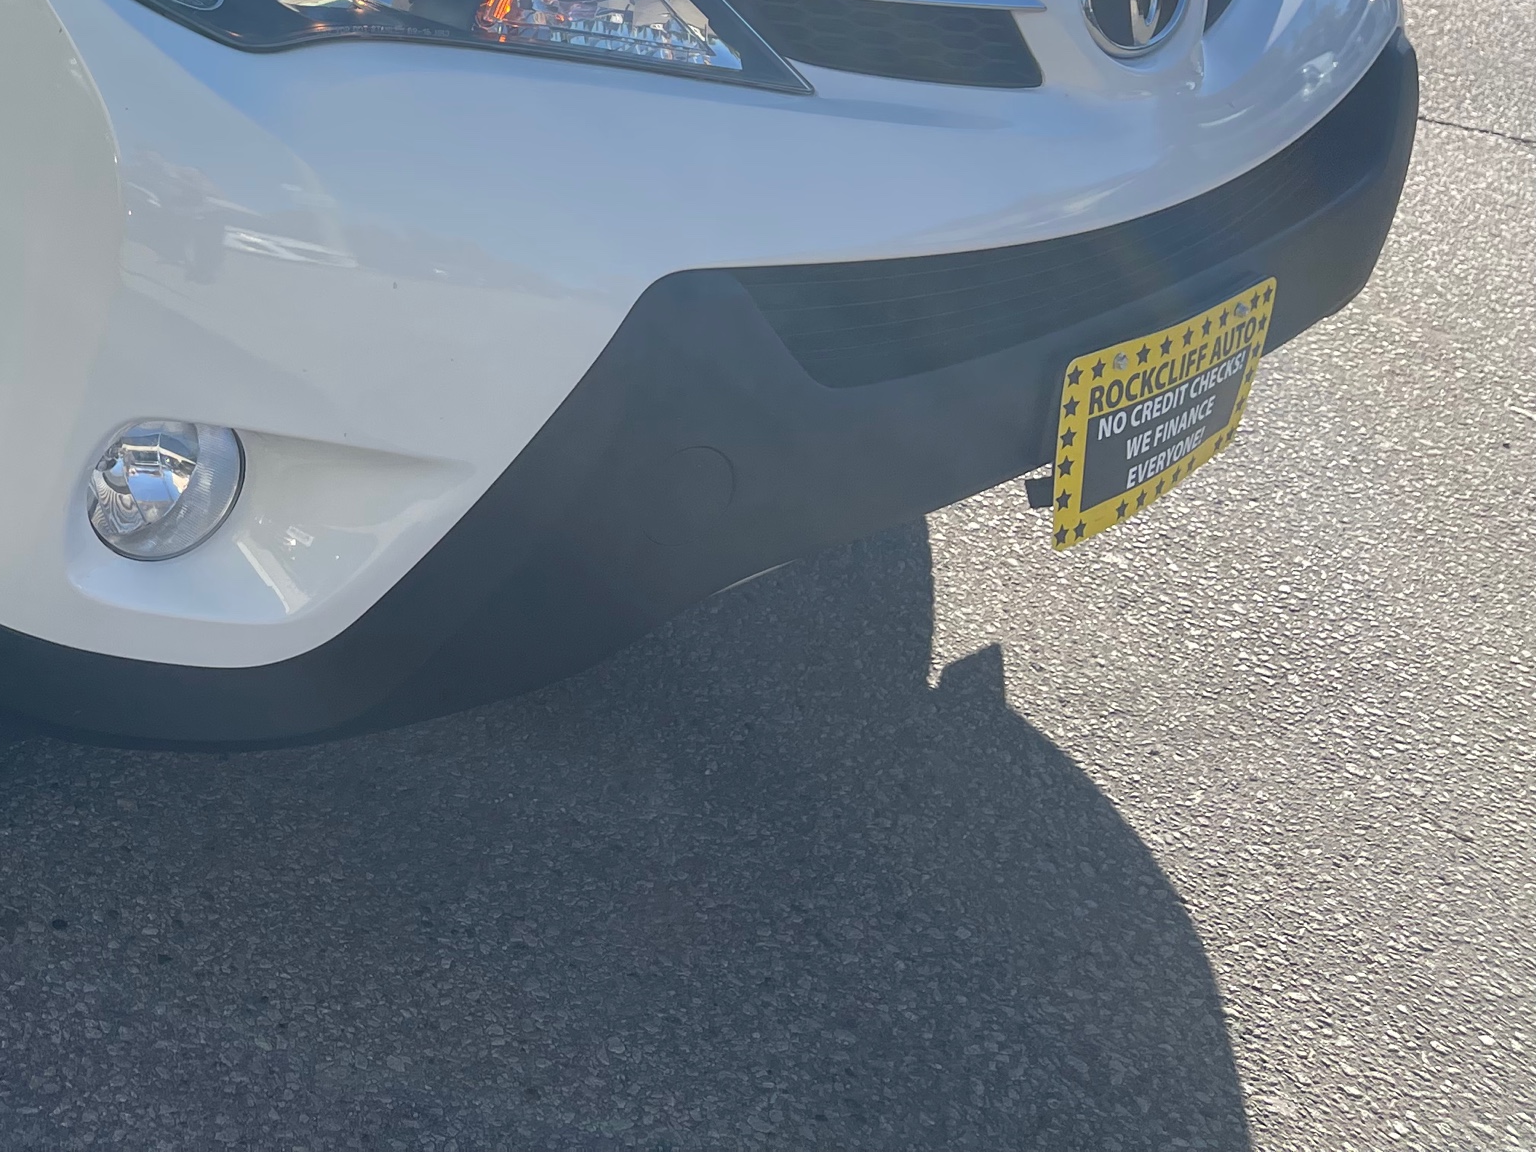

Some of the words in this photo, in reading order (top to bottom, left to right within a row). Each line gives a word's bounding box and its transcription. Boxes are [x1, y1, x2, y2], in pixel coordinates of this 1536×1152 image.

[1088, 344, 1207, 416] ROCKCLIFF
[1209, 316, 1257, 366] AUTO
[1097, 411, 1127, 441] NO
[1131, 384, 1188, 427] CREDIT
[1189, 352, 1247, 400] CHECKS!
[1126, 432, 1151, 460] WE
[1153, 395, 1216, 447] FINANCE
[1126, 426, 1206, 489] EVERYONE!
